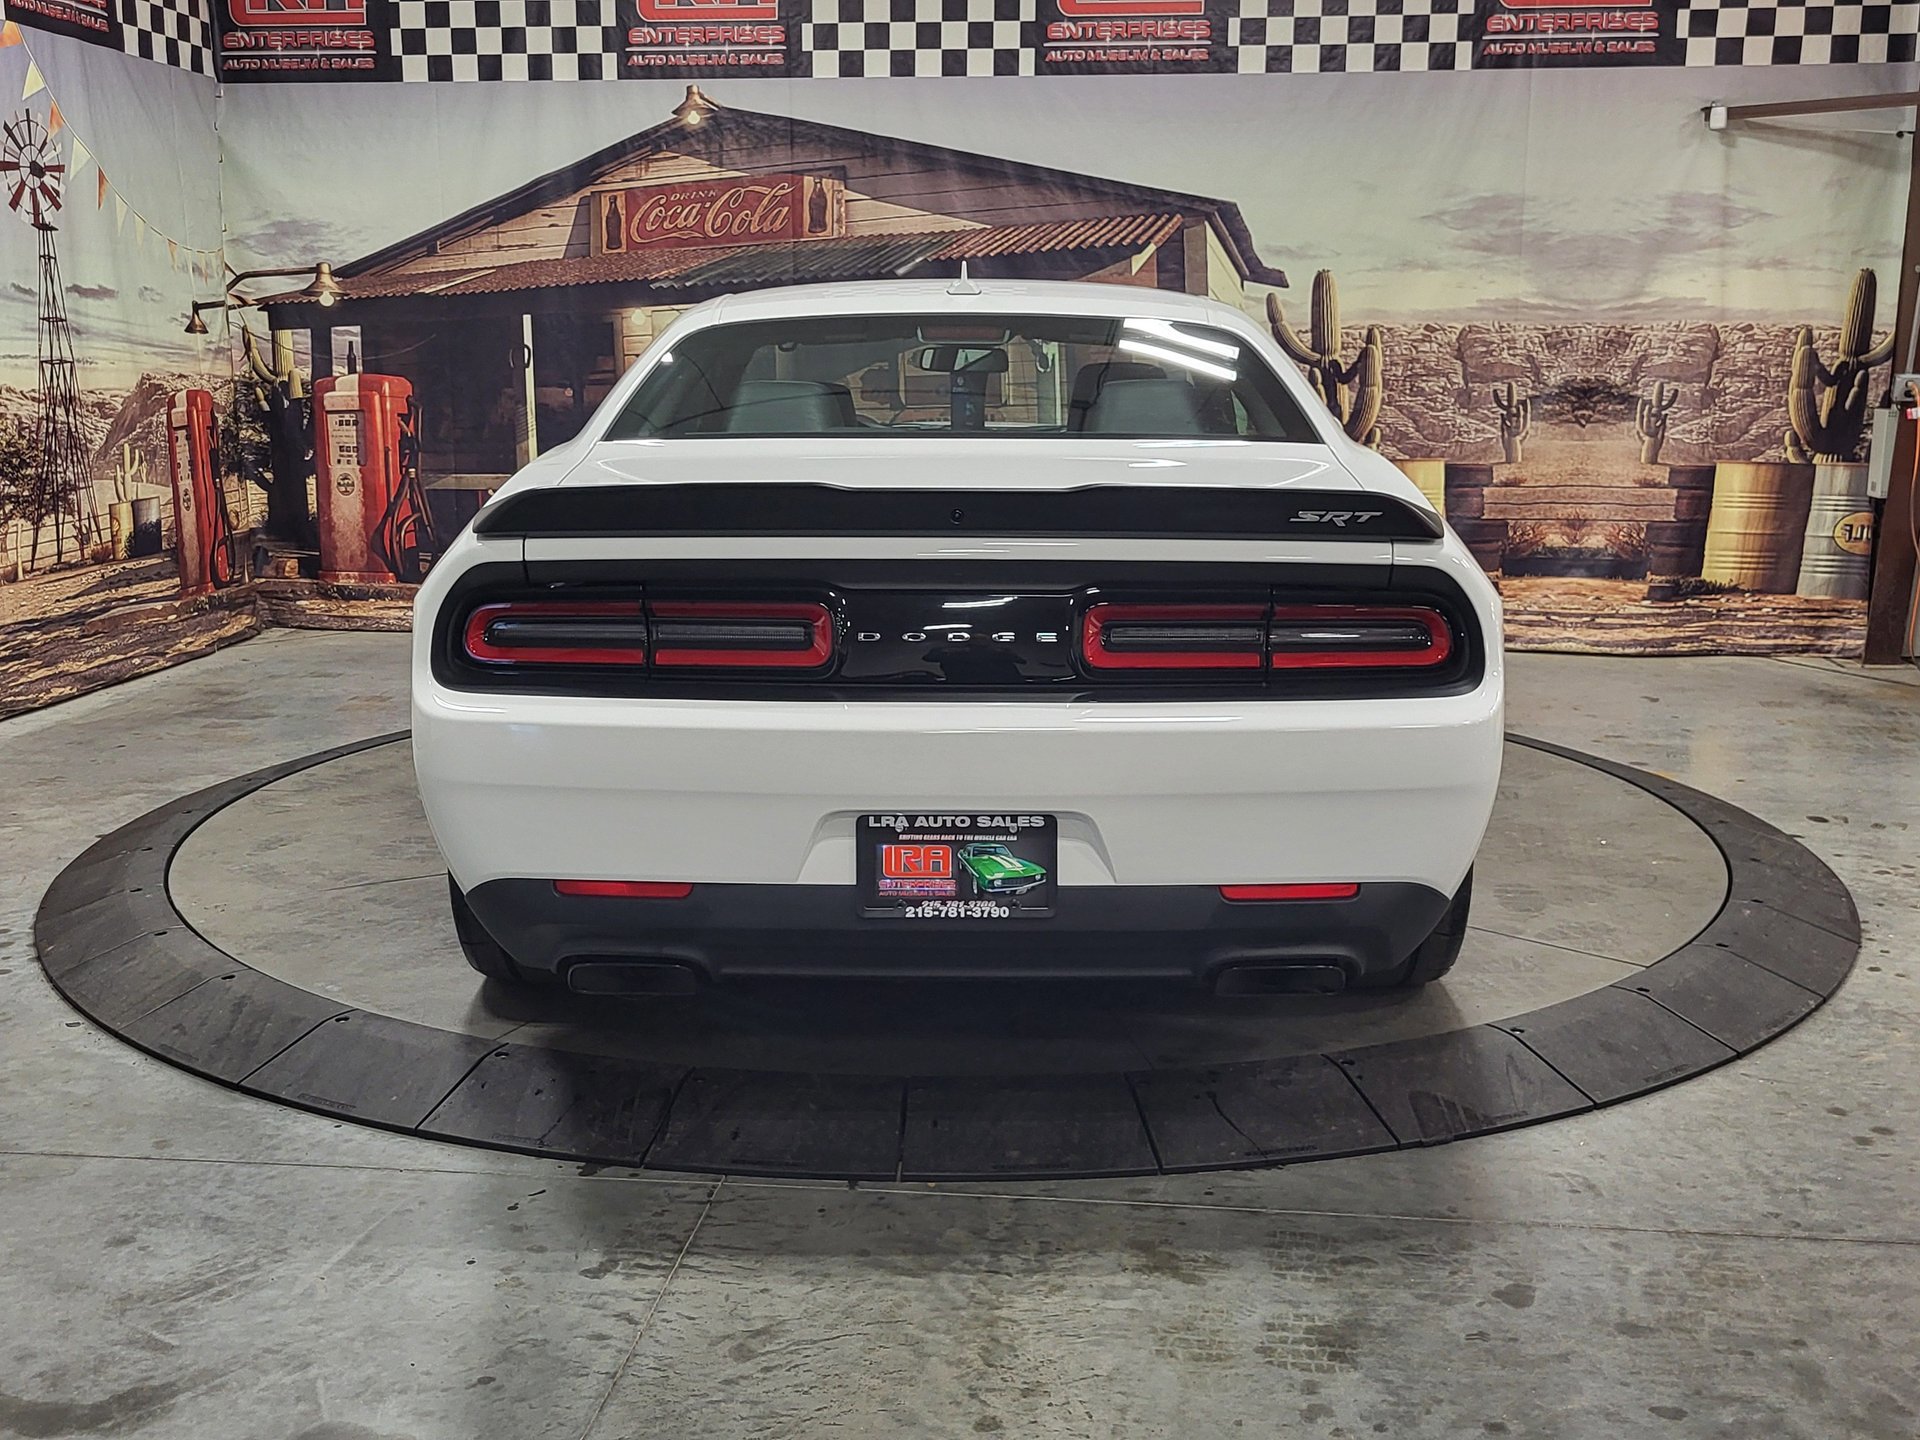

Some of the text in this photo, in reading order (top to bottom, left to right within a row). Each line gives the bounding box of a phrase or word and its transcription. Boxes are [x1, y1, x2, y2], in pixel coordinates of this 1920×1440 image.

[1486, 12, 1659, 32] ENTERPRISES
[628, 26, 786, 44] ENTERPRISES
[1047, 20, 1211, 39] ENTERPRISES
[223, 30, 375, 48] ENTERPRISES
[1045, 48, 1209, 62] AUTO MUSEUM & SALES
[1483, 41, 1656, 55] AUTO MUSEUM & SALES
[223, 57, 375, 70] AUTO MUSEUM & SALES
[627, 53, 785, 66] AUTO MUSEUM & SALES
[670, 190, 719, 201] DRINK
[630, 182, 796, 243] Coca-Cola
[1289, 511, 1383, 527] SRT
[857, 632, 1058, 642] DODGE
[868, 816, 1045, 828] LRA AUTO SALES
[883, 845, 953, 878] LRA
[905, 906, 1009, 918] 215-781-3790
